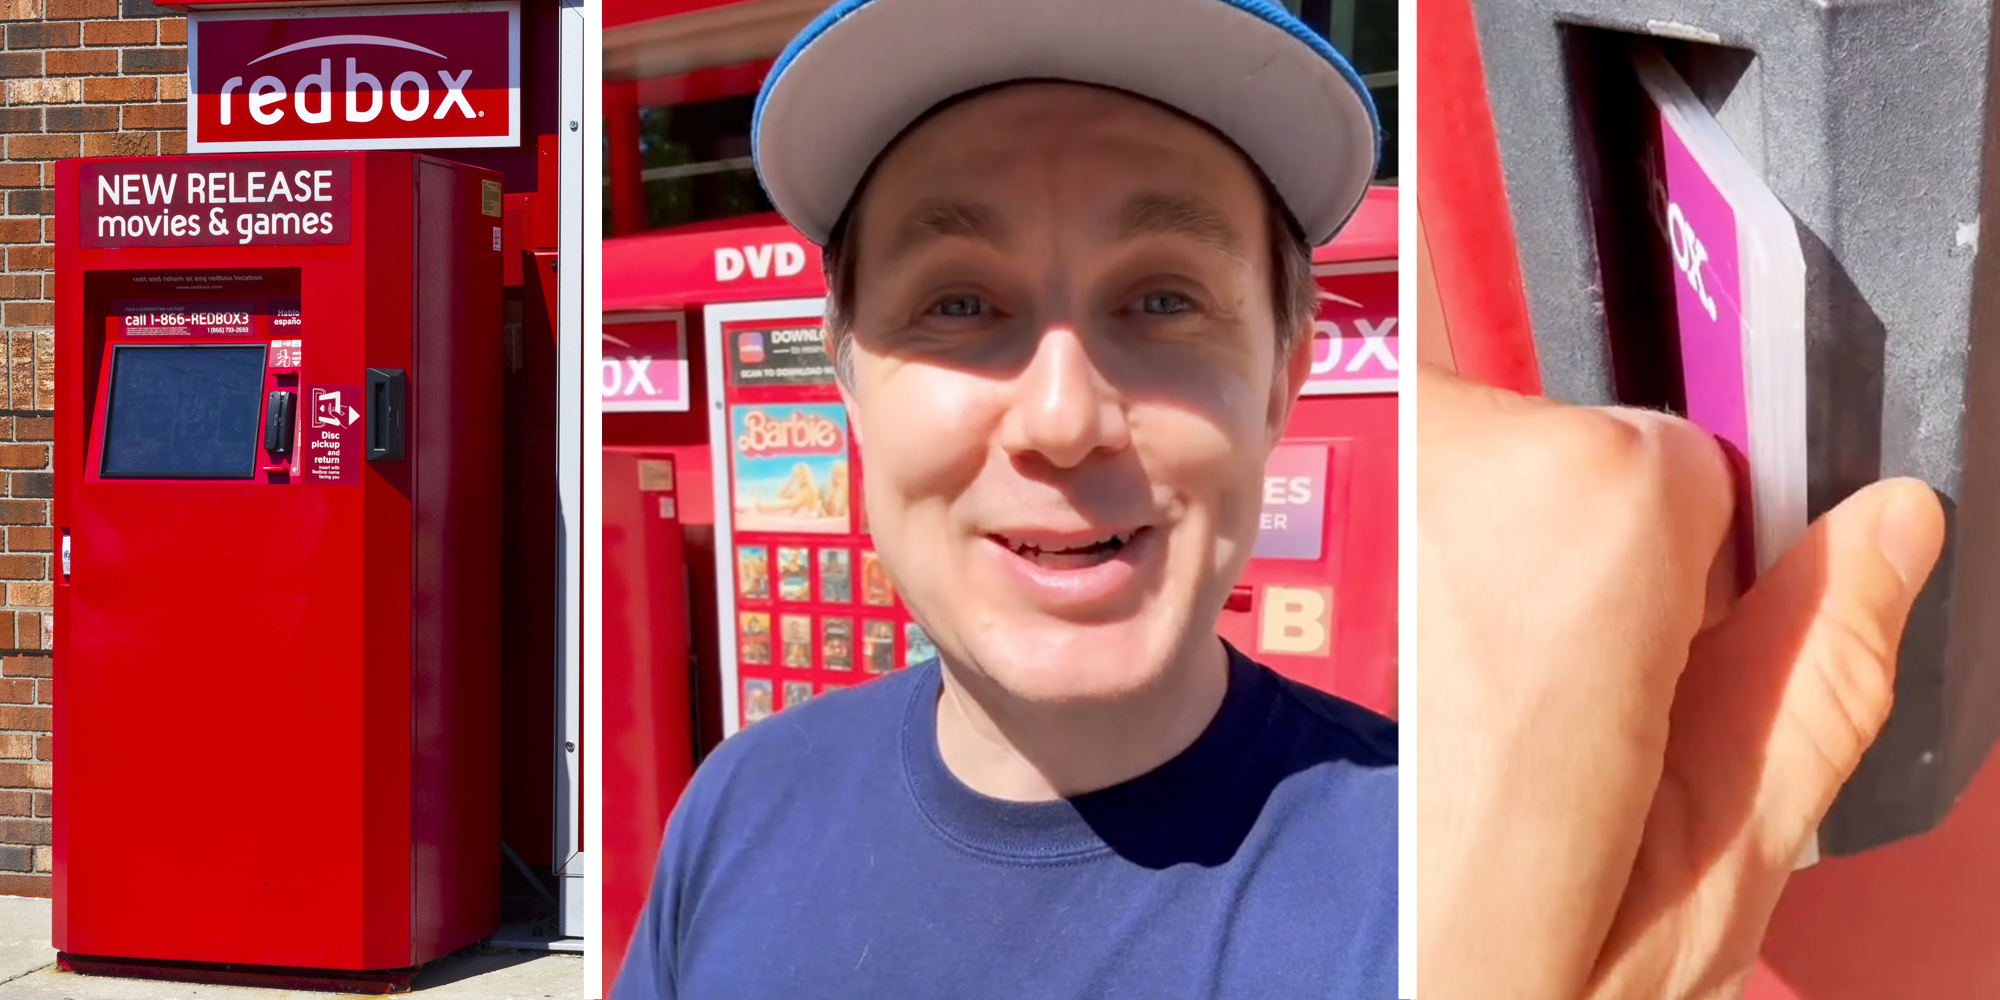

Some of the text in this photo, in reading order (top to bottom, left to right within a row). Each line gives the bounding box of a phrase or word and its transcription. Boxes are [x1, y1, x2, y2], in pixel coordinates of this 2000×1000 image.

[98, 170, 333, 206] NEW RELEASE
[98, 207, 333, 244] movies & games
[714, 242, 806, 282] DVD
[194, 275, 206, 283] any
[207, 274, 232, 282] redbox
[232, 273, 263, 281] location
[125, 312, 249, 327] call 1-866-REDBOX3
[740, 369, 763, 378] SCAN
[764, 369, 775, 377] TO
[776, 366, 823, 377] DOWNLOAD
[321, 431, 340, 439] Disc
[738, 411, 838, 452] Barbie
[311, 440, 340, 450] pickup
[314, 456, 340, 464] return
[1262, 587, 1325, 652] B
